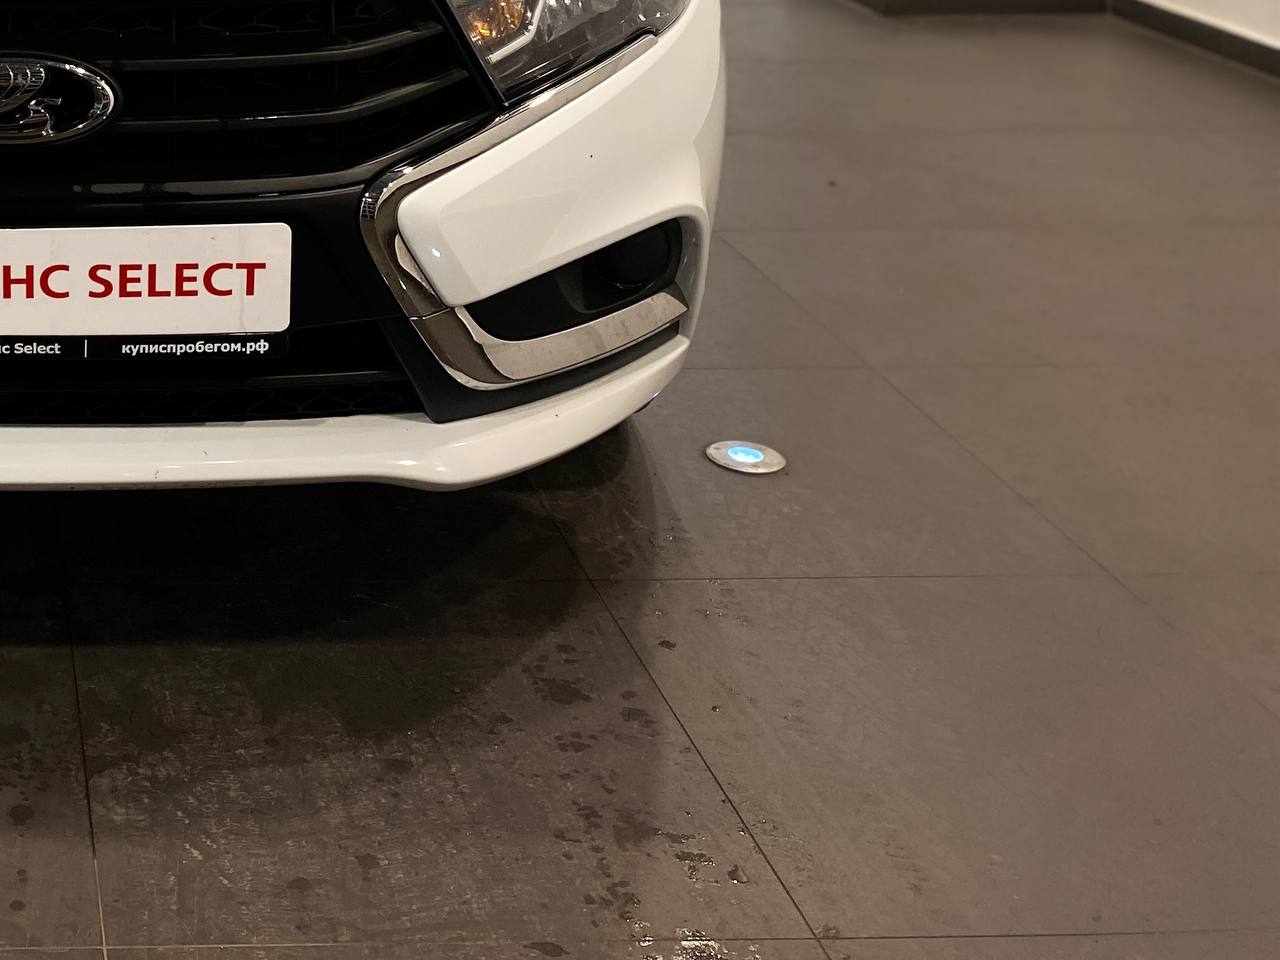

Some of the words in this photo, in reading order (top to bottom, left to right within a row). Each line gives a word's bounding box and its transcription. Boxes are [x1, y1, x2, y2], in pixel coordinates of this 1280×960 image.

[87, 261, 267, 299] SELECT
[14, 342, 61, 355] Select
[121, 339, 270, 356] куписпробегом.рф
